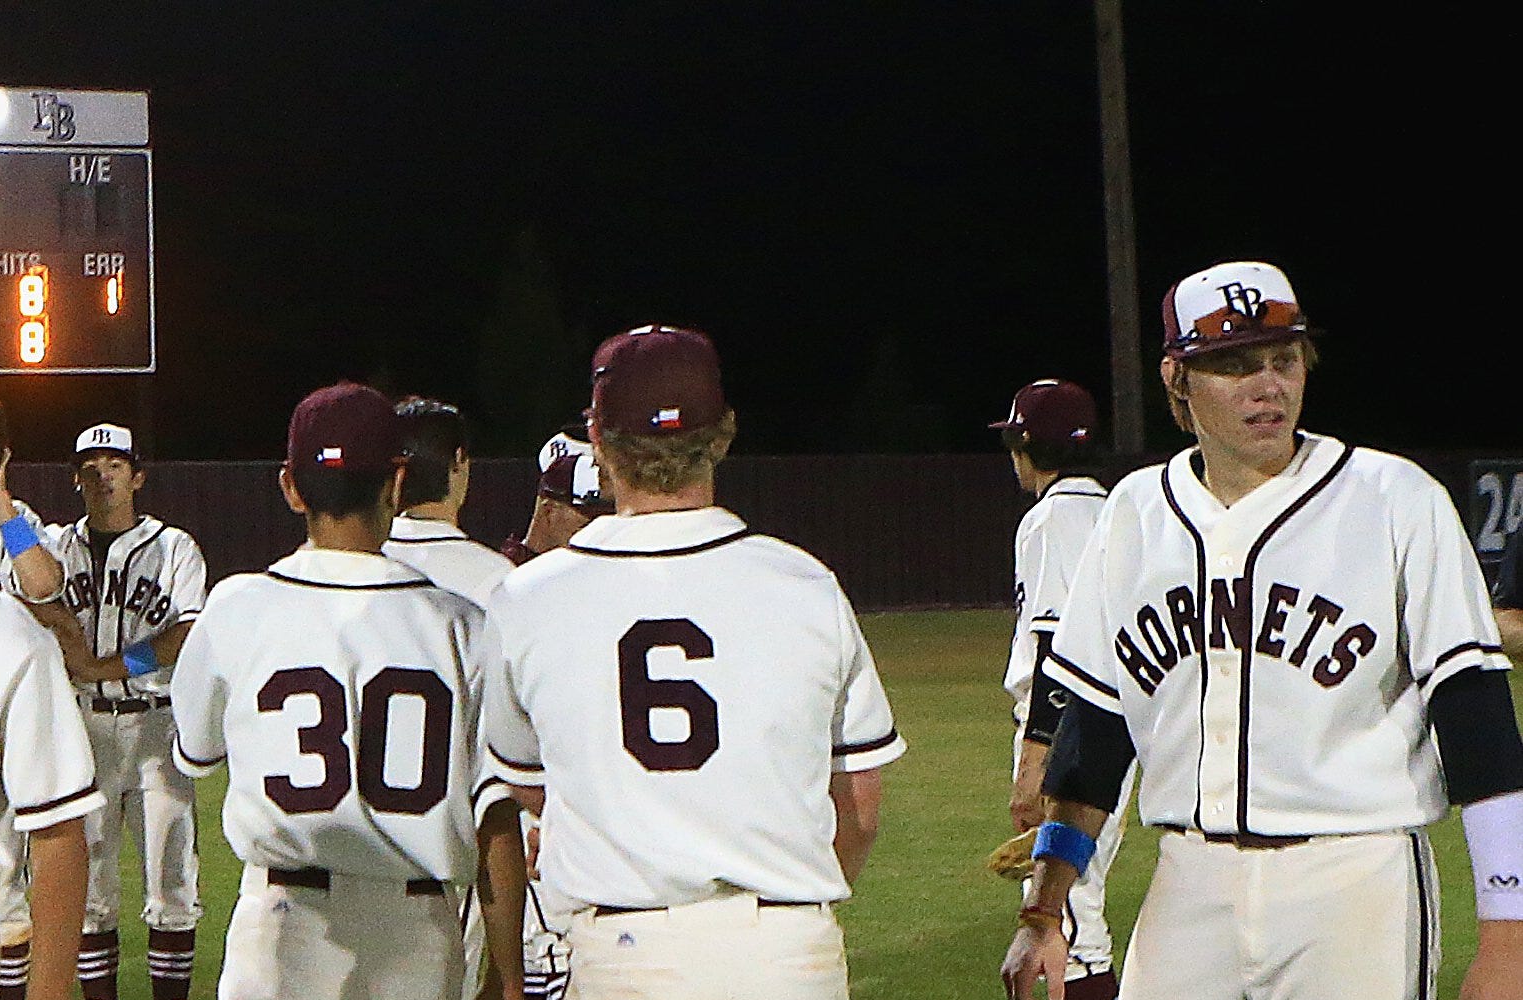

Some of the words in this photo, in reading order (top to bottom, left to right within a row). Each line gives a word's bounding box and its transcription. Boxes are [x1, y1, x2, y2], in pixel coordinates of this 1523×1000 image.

[69, 157, 114, 184] H/E
[84, 254, 125, 276] ERR
[19, 275, 44, 317] 8
[19, 321, 45, 363] 8
[1114, 576, 1377, 697] HORNETS
[618, 617, 720, 771] 6
[257, 667, 453, 814] 30
